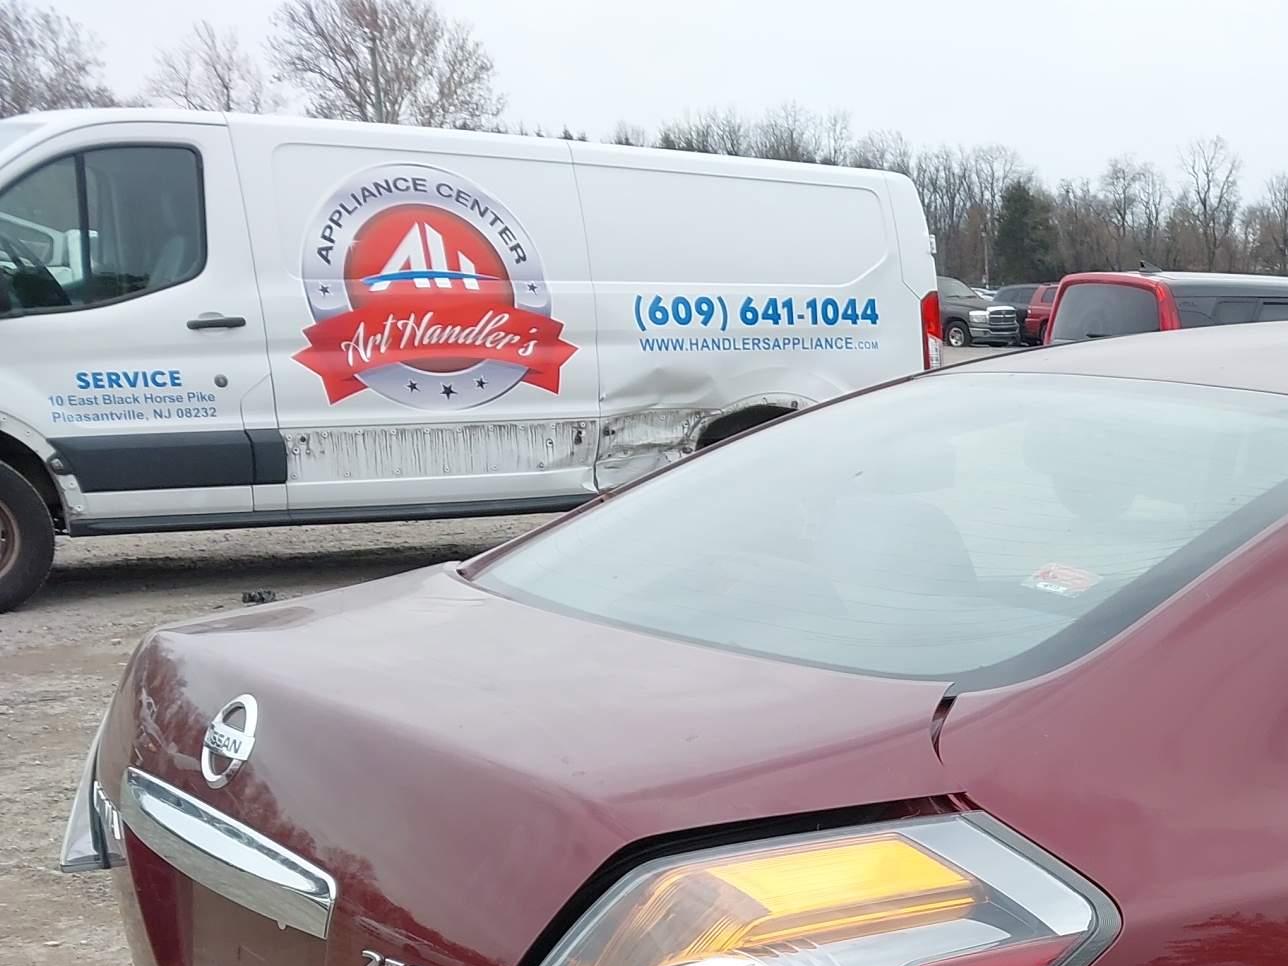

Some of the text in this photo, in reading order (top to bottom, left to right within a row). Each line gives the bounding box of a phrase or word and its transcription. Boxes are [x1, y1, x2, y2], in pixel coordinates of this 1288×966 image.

[317, 177, 527, 265] APPLIANCE CENTER
[635, 295, 879, 332] (609) 641-1044
[341, 310, 538, 366] Art Handler's
[76, 370, 183, 390] SERVICE
[49, 391, 216, 407] 10 East Black Horse Pike
[153, 408, 171, 419] NJ
[176, 406, 217, 419] 08232
